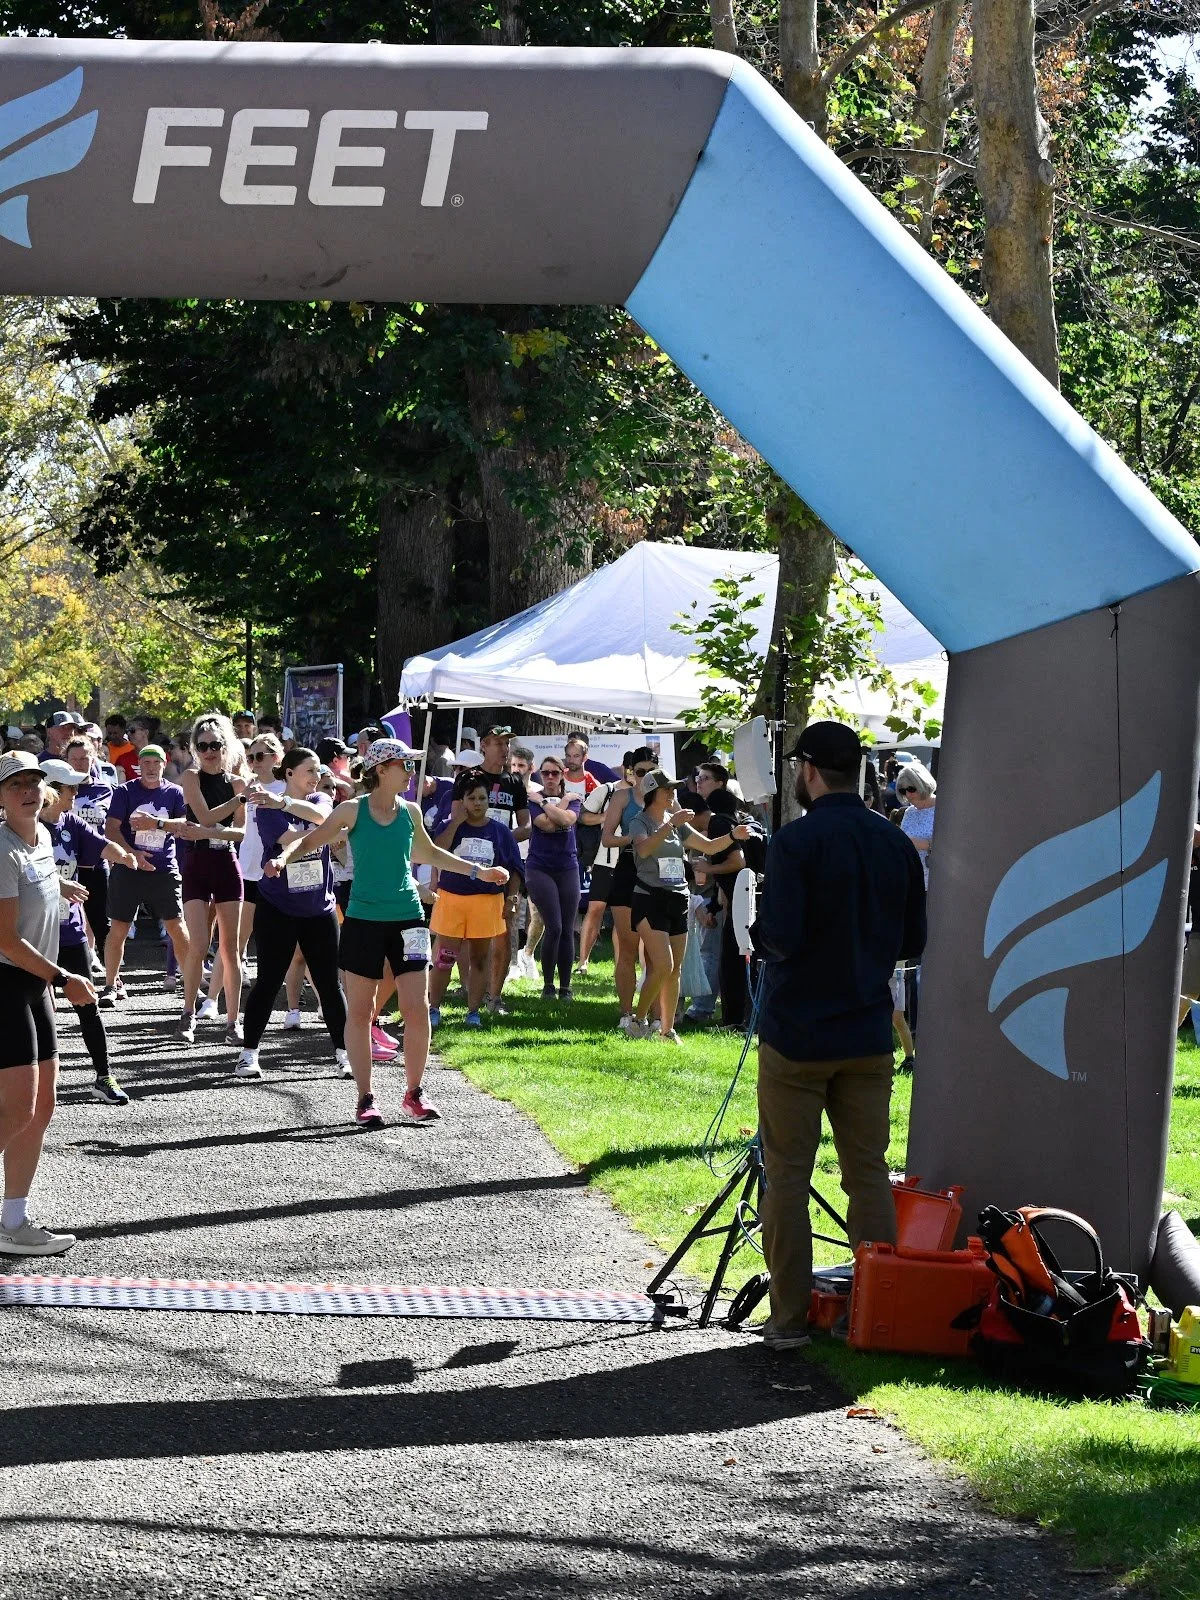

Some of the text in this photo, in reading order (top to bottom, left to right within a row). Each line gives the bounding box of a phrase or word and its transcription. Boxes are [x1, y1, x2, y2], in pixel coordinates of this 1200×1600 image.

[132, 106, 490, 208] FEET
[498, 791, 513, 801] CITY
[141, 833, 160, 844] 102
[468, 845, 488, 855] 185
[294, 870, 318, 883] 263
